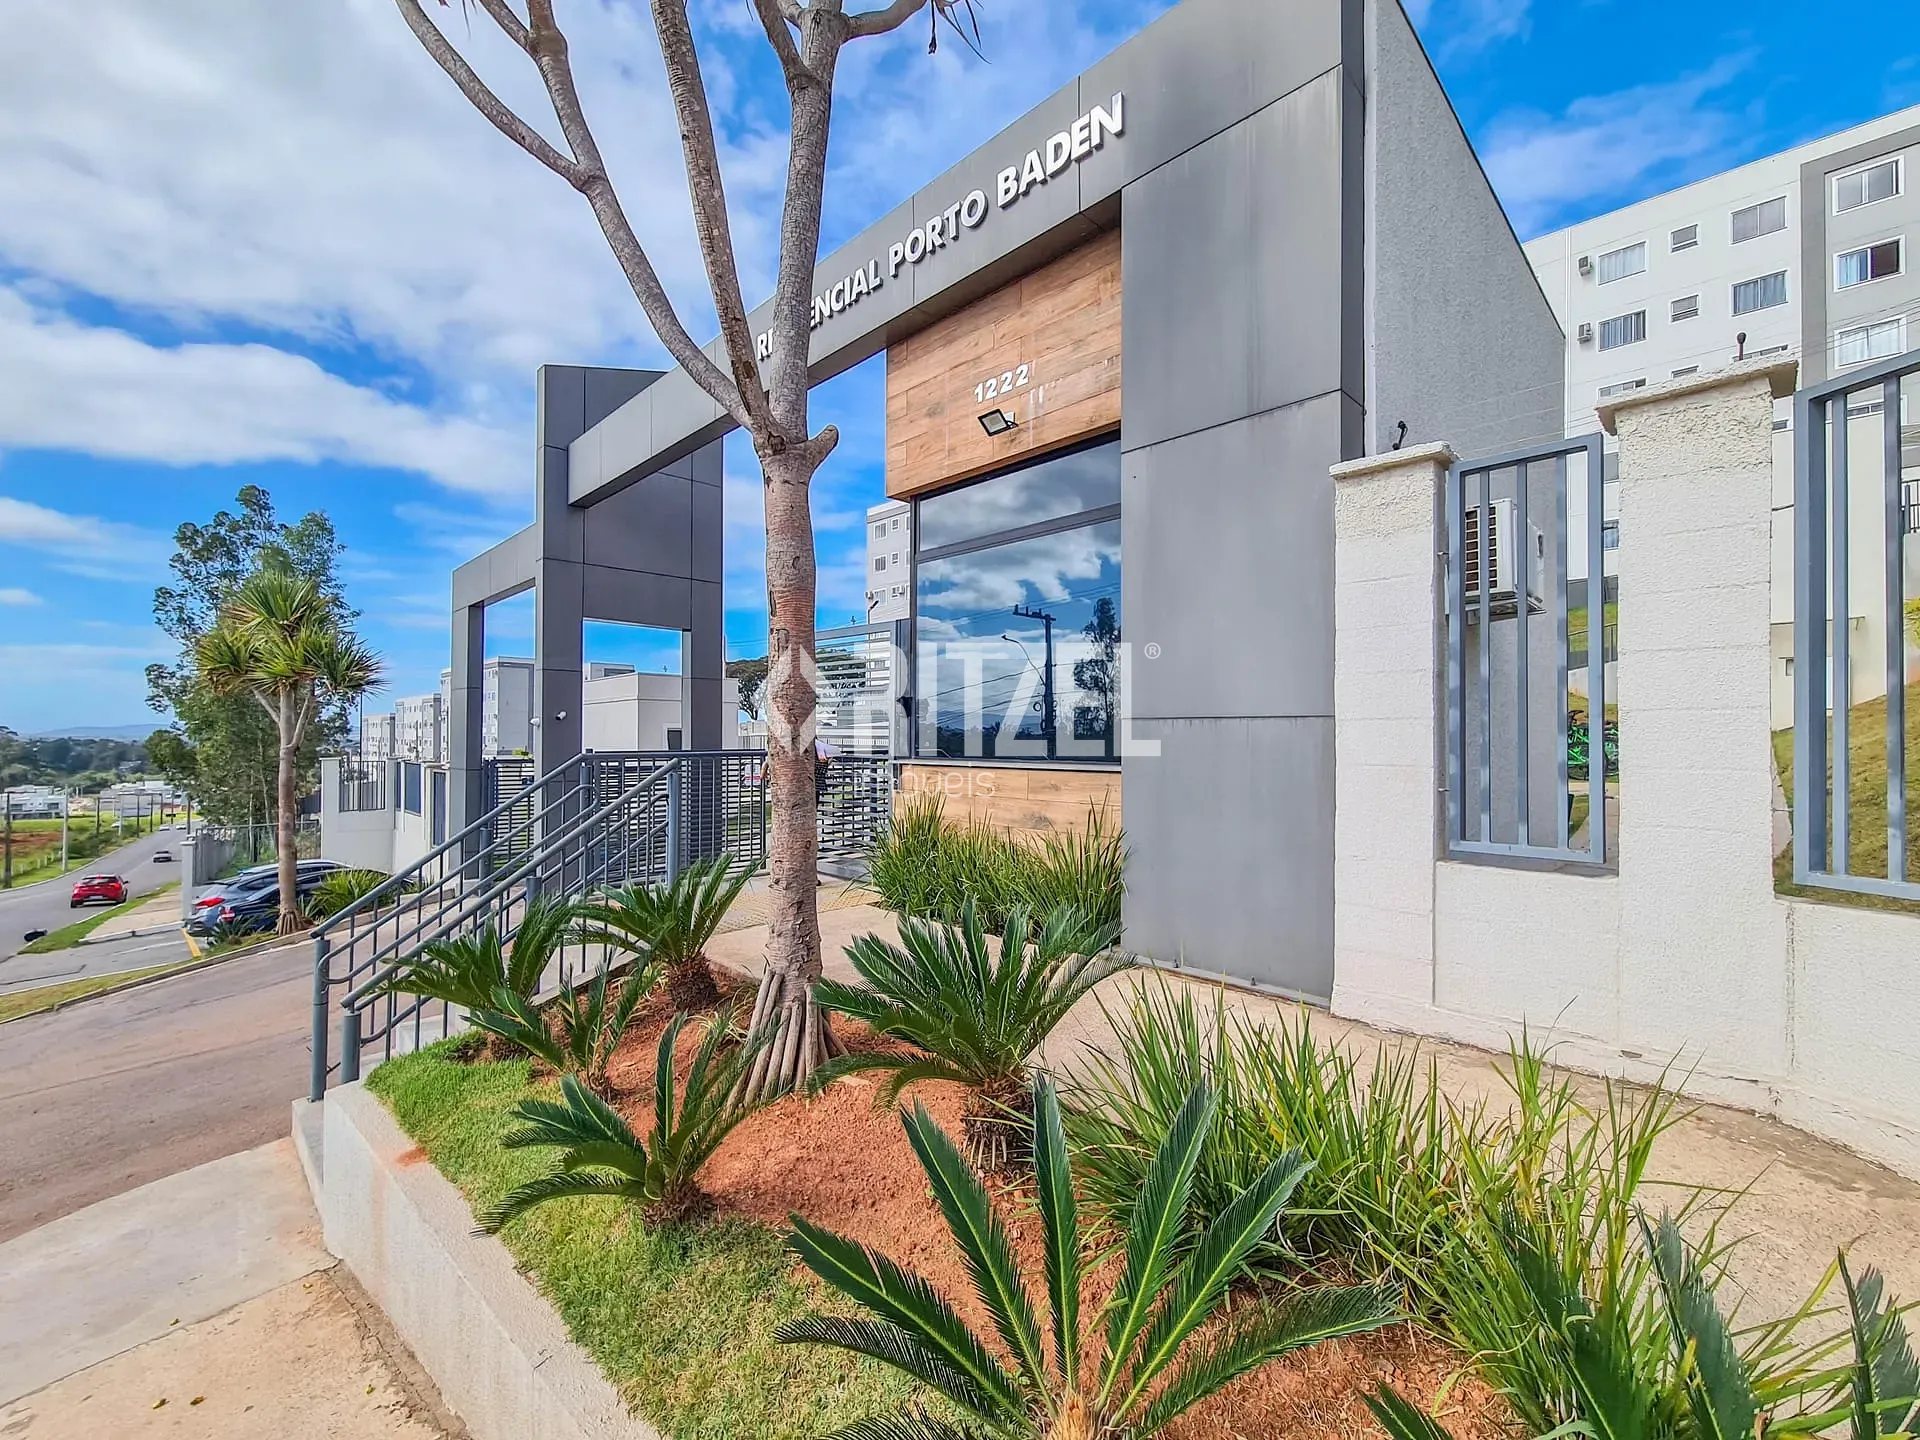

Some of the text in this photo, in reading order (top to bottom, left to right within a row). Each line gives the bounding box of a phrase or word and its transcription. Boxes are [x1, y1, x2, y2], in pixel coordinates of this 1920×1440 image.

[757, 91, 1124, 361] RENCIAL PORTO BADEN
[974, 363, 1029, 403] 1222
